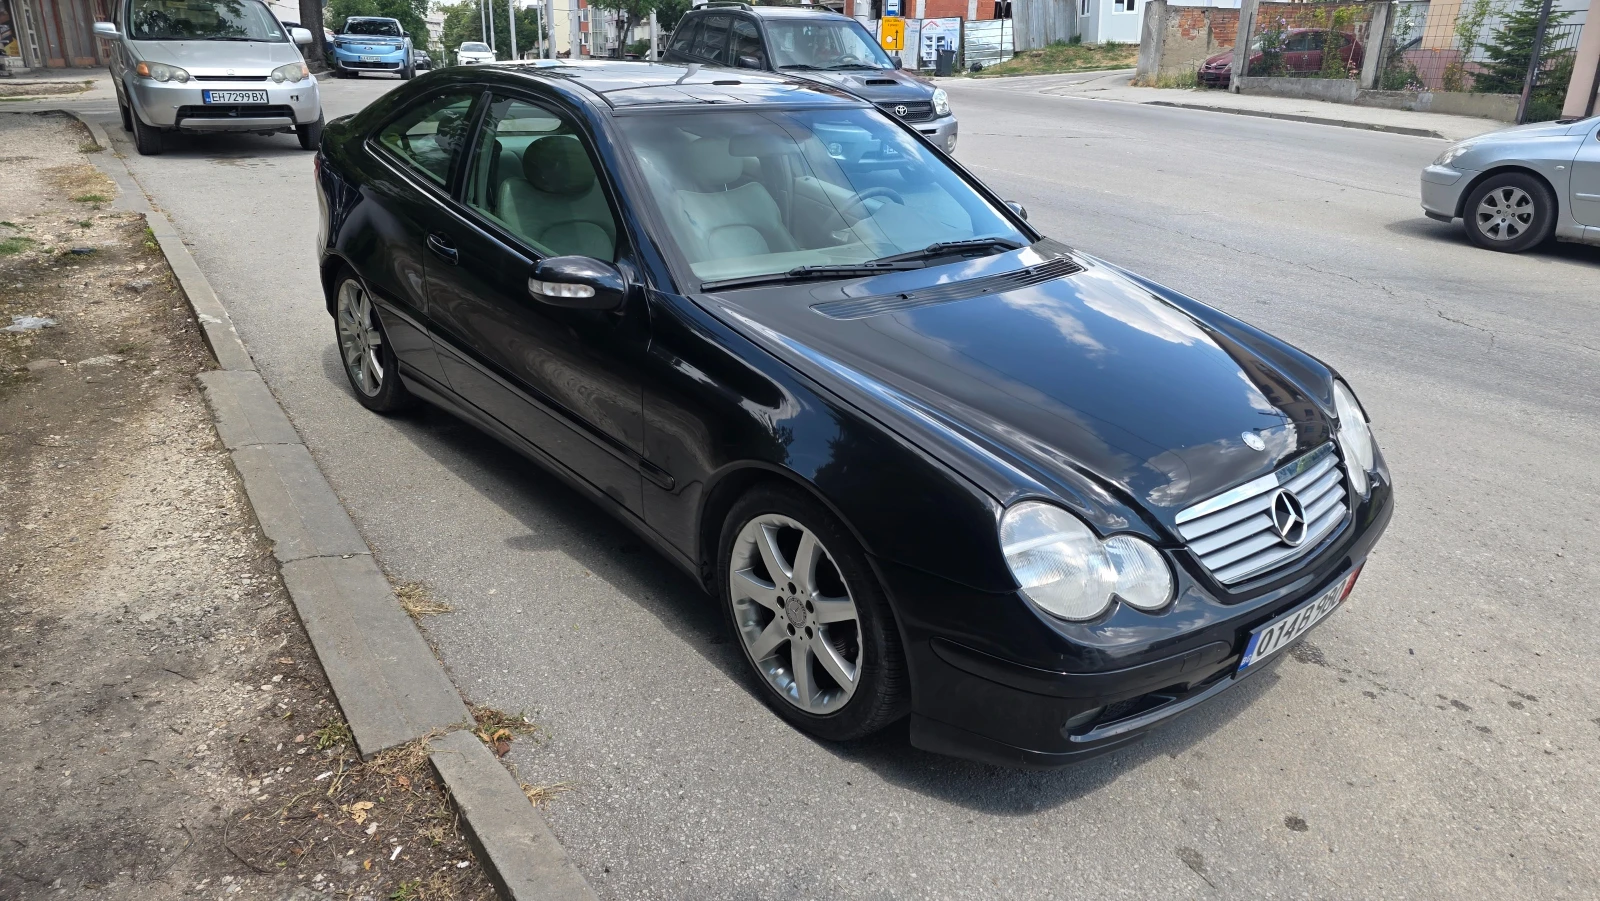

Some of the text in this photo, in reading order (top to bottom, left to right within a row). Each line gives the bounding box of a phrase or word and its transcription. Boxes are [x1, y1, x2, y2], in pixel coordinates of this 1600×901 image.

[211, 92, 226, 102] EH
[226, 92, 251, 102] 7299
[251, 92, 266, 102] BX
